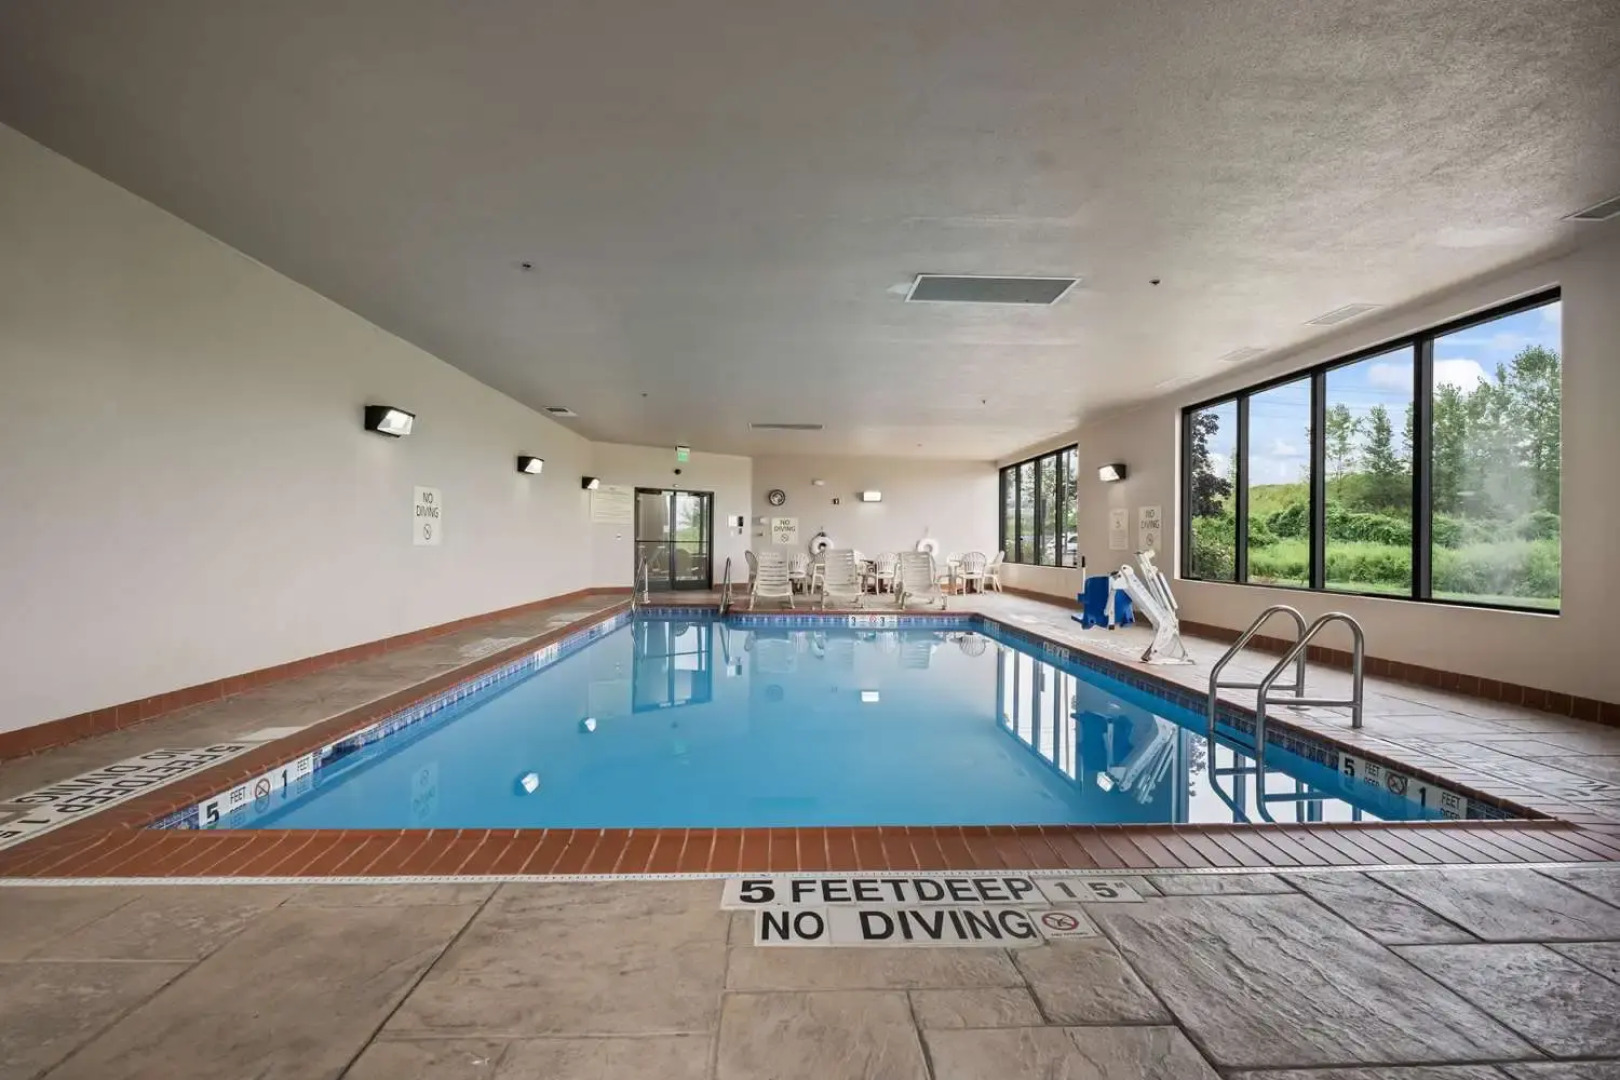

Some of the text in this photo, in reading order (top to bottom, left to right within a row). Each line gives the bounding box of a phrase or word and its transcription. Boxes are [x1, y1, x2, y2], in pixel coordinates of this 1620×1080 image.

[422, 491, 433, 504] NO
[416, 504, 439, 519] DIVING
[281, 769, 288, 787] 1
[297, 757, 310, 771] FEET
[1344, 757, 1381, 778] 5 FEET
[206, 801, 220, 824] 5
[230, 786, 246, 804] FEET
[1419, 786, 1461, 810] 1 FEET
[739, 878, 776, 904] 5
[761, 908, 1037, 941] NO DIVING
